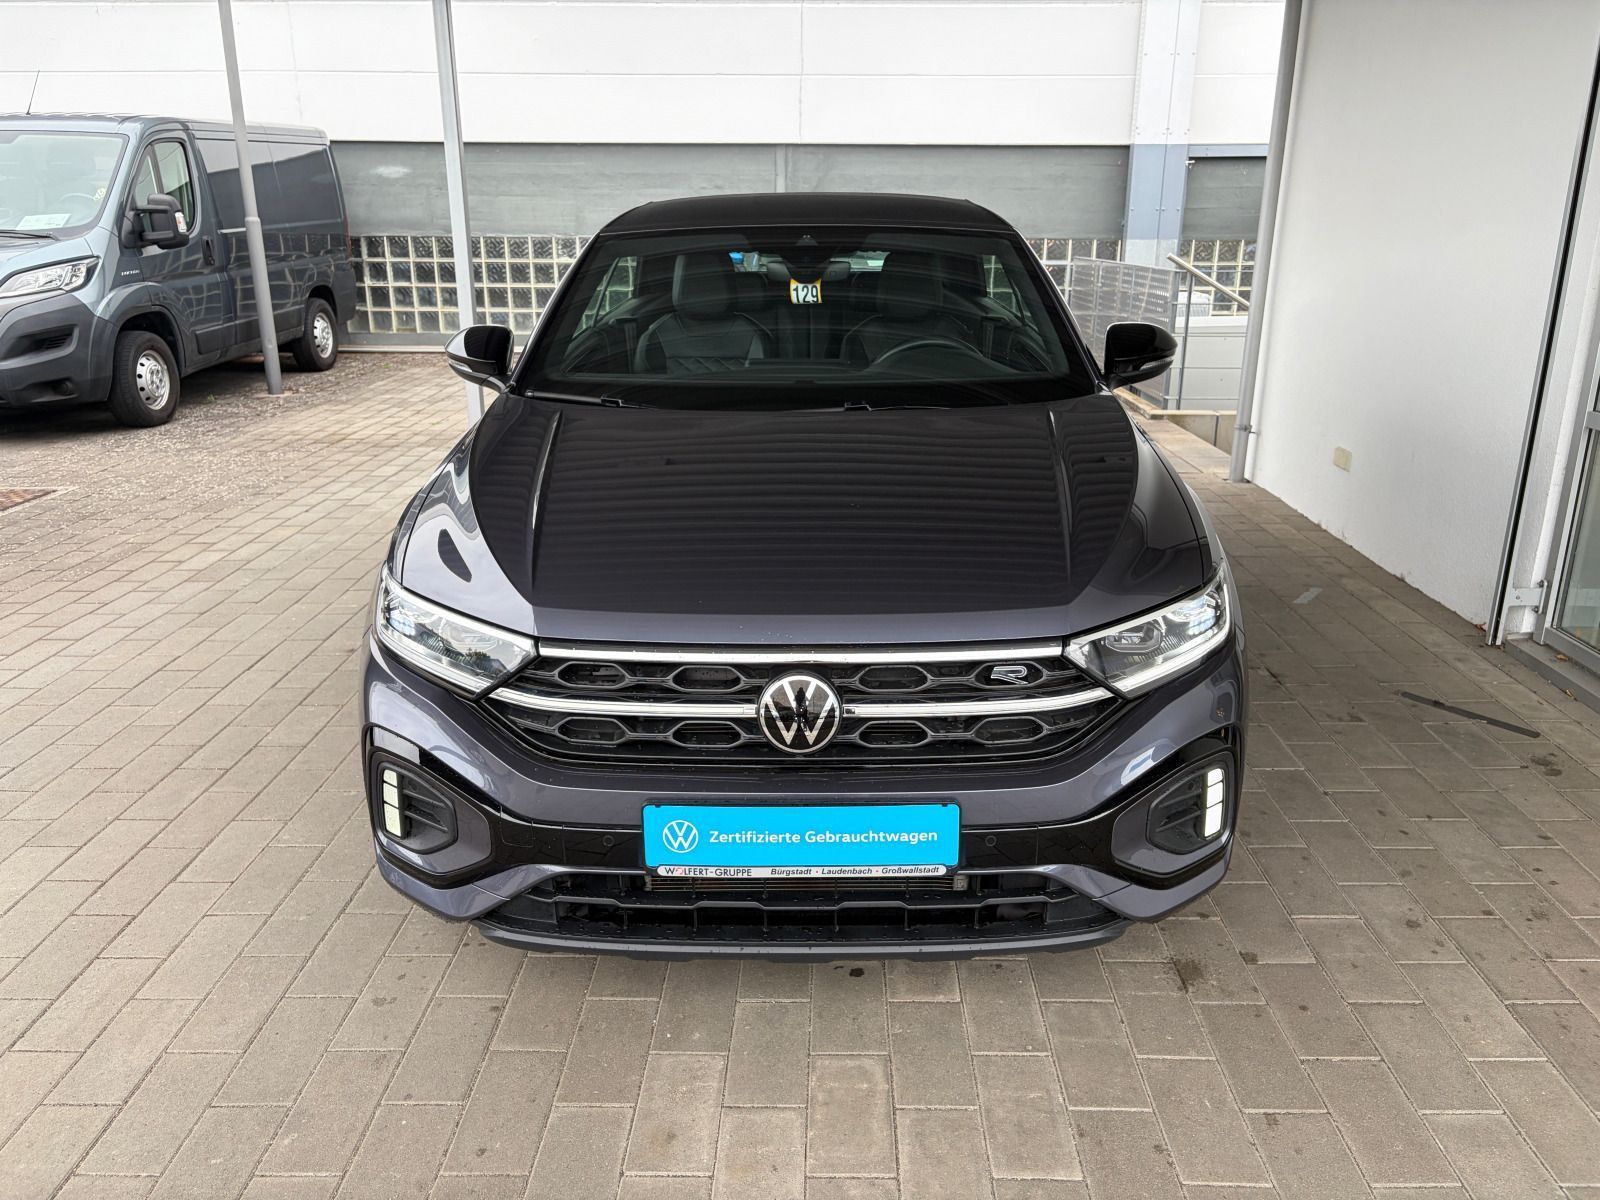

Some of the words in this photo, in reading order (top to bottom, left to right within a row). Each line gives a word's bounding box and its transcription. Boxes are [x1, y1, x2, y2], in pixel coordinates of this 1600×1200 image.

[792, 284, 819, 304] 129
[708, 830, 801, 844] Zertifizierte
[804, 830, 939, 845] Gebrauchtwagen
[664, 866, 753, 877] WOLFERT-GRUPPE
[770, 867, 812, 877] Bürgstadt
[821, 867, 873, 875] Laudenbach
[881, 866, 940, 875] Großwallstadt
